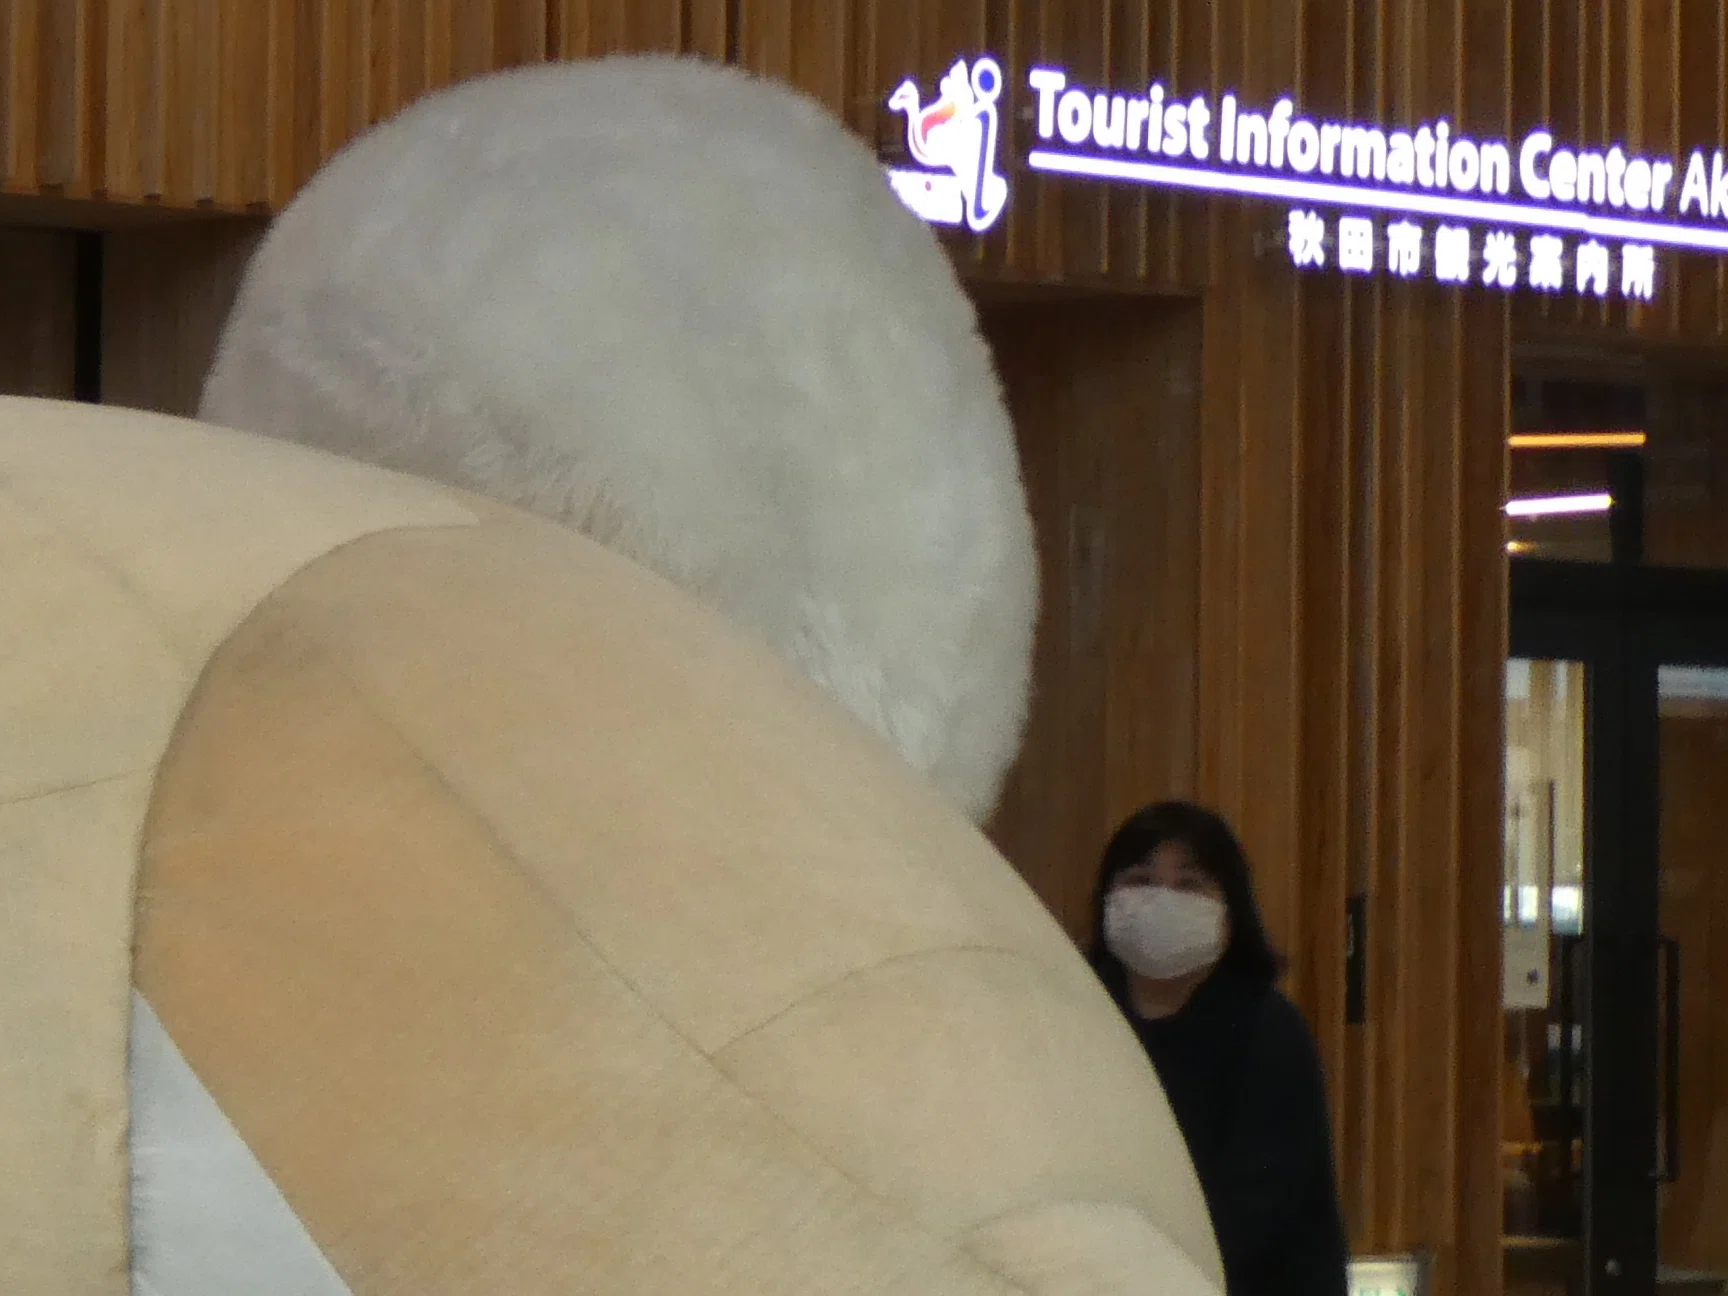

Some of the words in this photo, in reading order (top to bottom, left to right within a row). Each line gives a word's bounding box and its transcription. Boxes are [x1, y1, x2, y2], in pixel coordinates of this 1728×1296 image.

[1029, 68, 1211, 160] Tourist
[1220, 94, 1511, 196] Information
[1519, 131, 1673, 212] Center
[1287, 207, 1655, 301] 秋田市観光案内所
